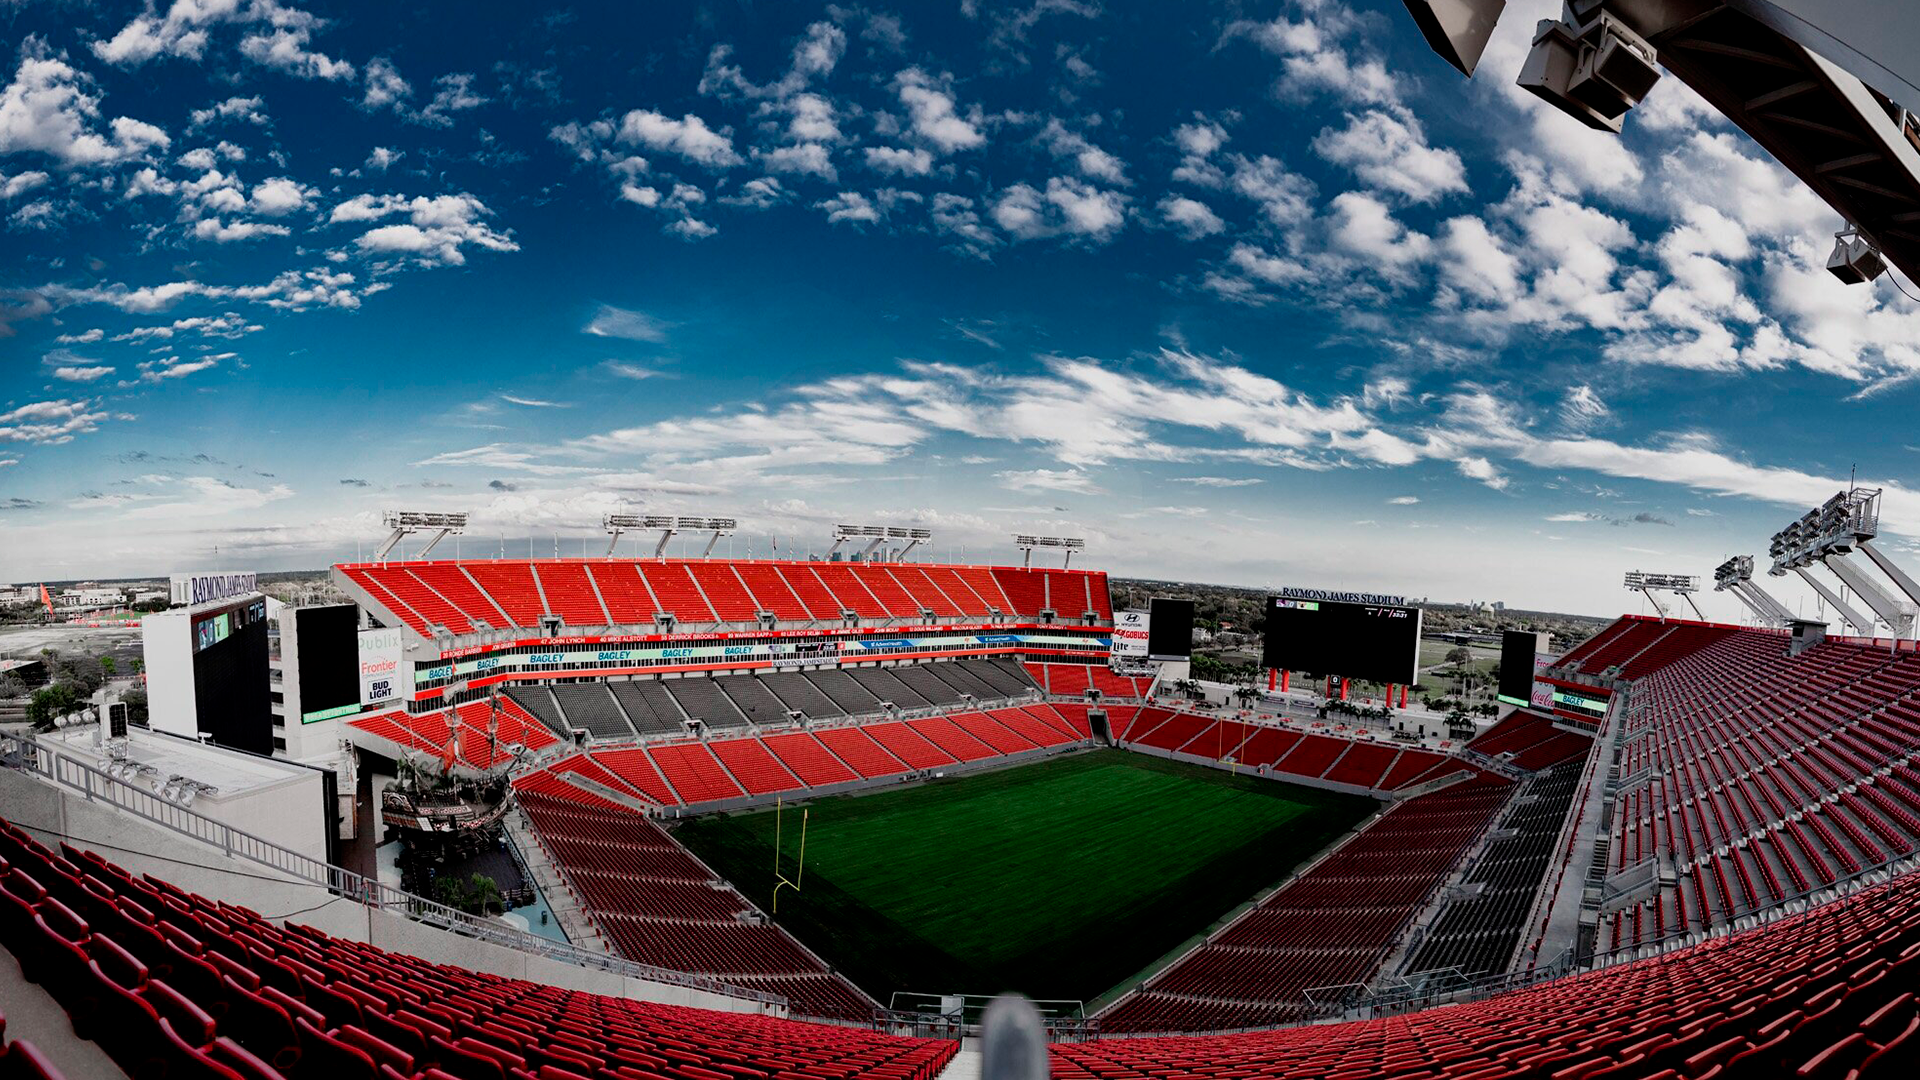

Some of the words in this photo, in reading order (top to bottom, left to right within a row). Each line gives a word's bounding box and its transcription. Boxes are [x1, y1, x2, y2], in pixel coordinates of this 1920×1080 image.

[191, 576, 226, 605] RAYMOND
[1282, 587, 1327, 600] RAYMOND
[1328, 591, 1360, 603] JAMES
[1361, 593, 1405, 606] STADIUM
[598, 651, 631, 660] BAGLEY
[662, 648, 693, 658] BAGLEY
[725, 646, 753, 655] BAGLEY
[477, 658, 500, 669] BAGLEY
[530, 653, 564, 663] BAGLEY
[361, 659, 398, 675] Frontier
[372, 681, 389, 691] BUD
[369, 687, 392, 700] LIGHT
[1562, 694, 1585, 706] BAGLEY
